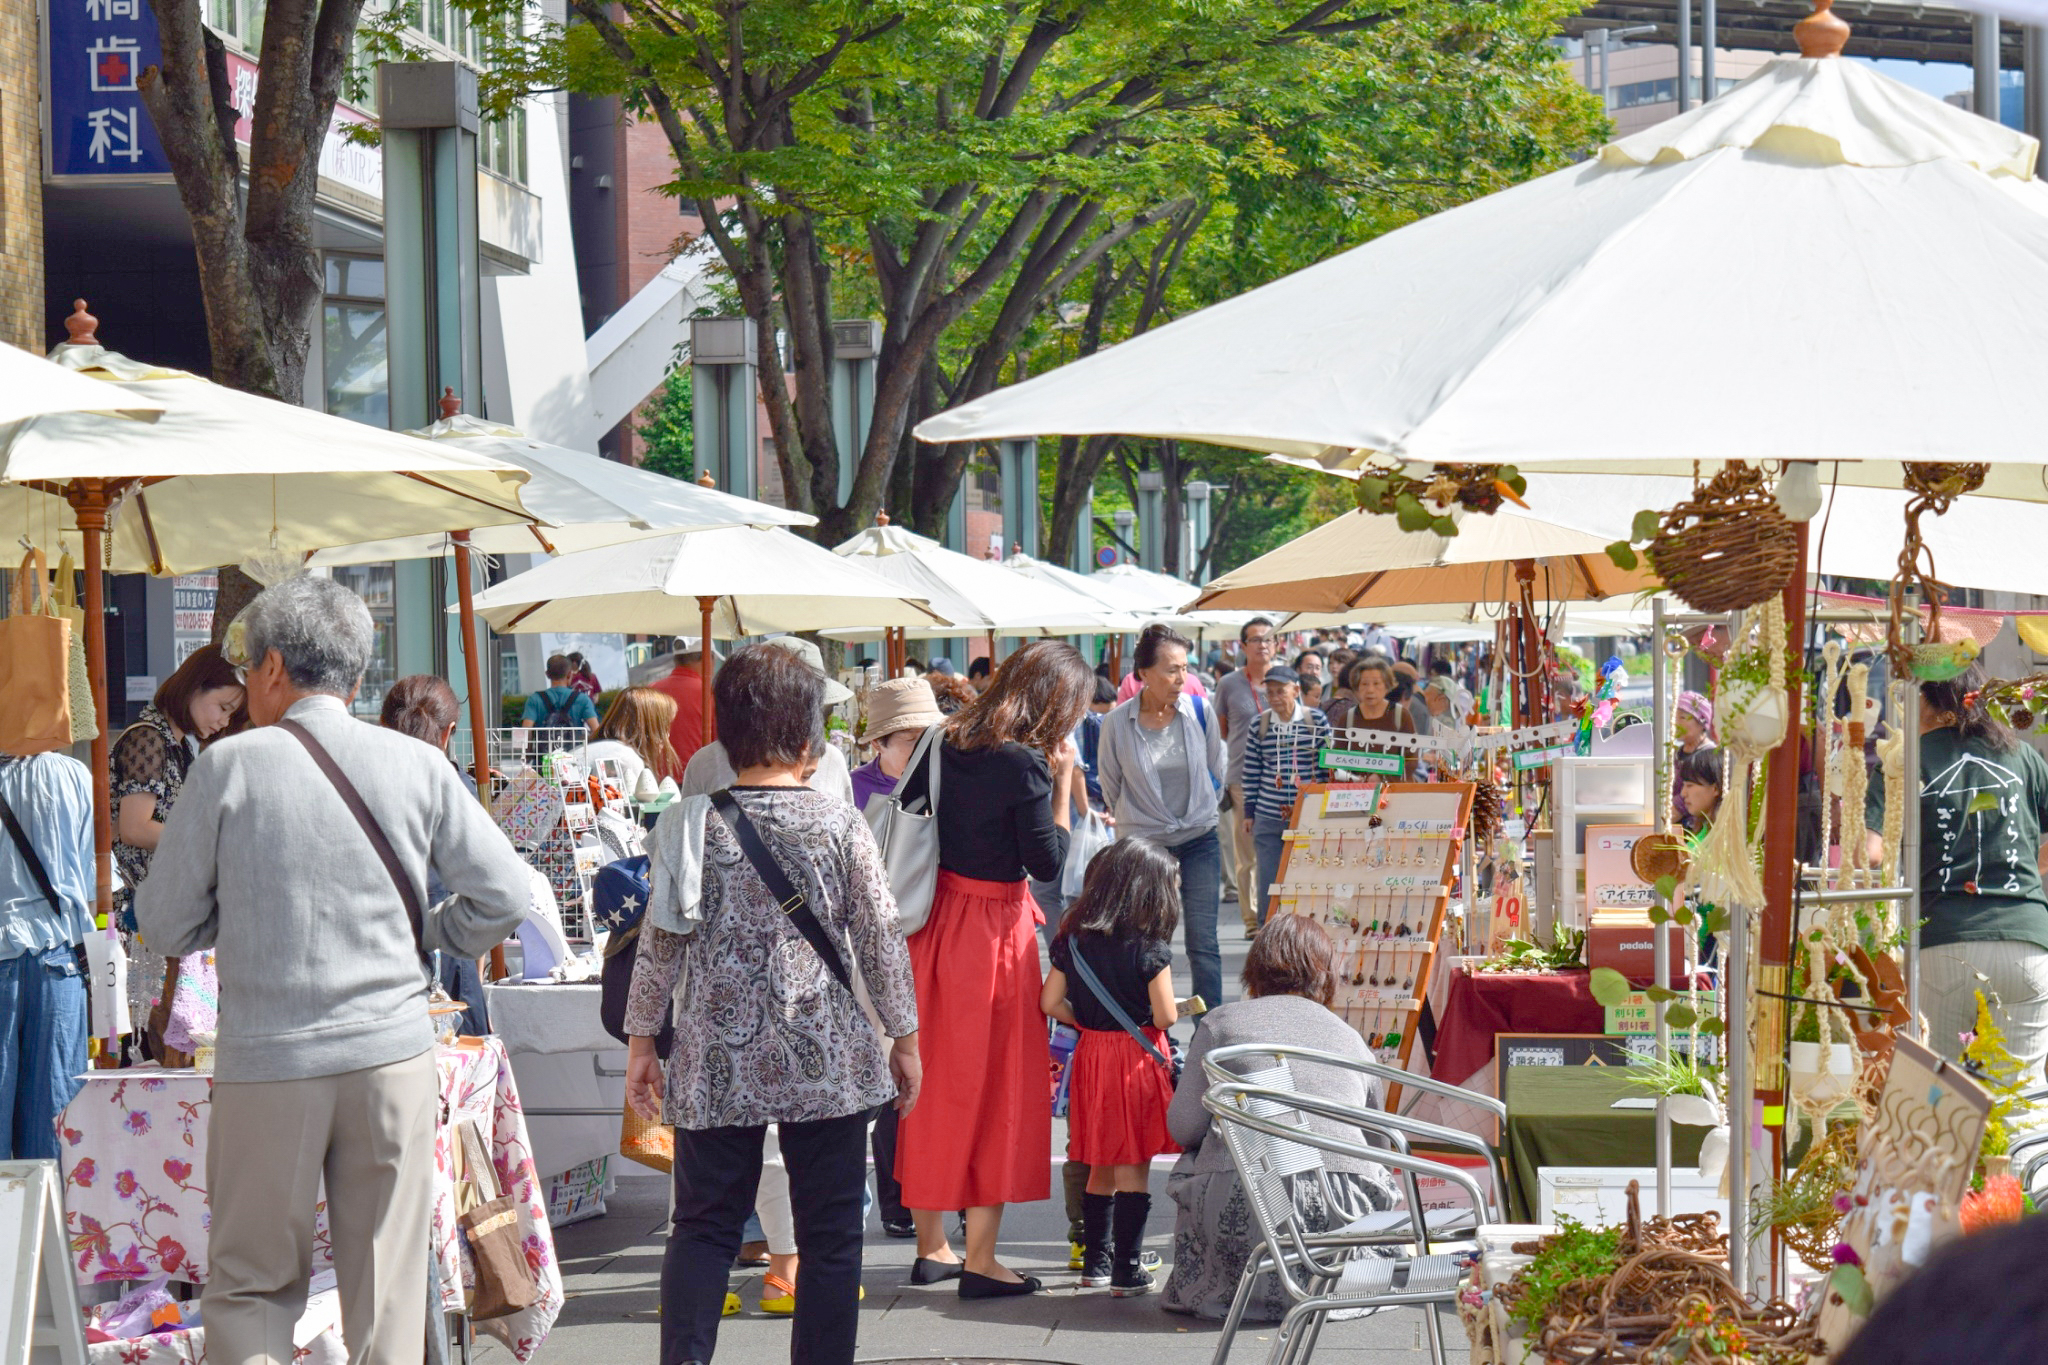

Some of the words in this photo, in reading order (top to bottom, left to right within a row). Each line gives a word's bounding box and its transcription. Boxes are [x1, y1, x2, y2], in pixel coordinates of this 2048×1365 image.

[1335, 756, 1360, 765] どんぐり
[1366, 758, 1383, 766] 200
[2000, 793, 2020, 892] ぱらそる
[1385, 876, 1415, 886] どんぐり
[106, 961, 116, 987] 3
